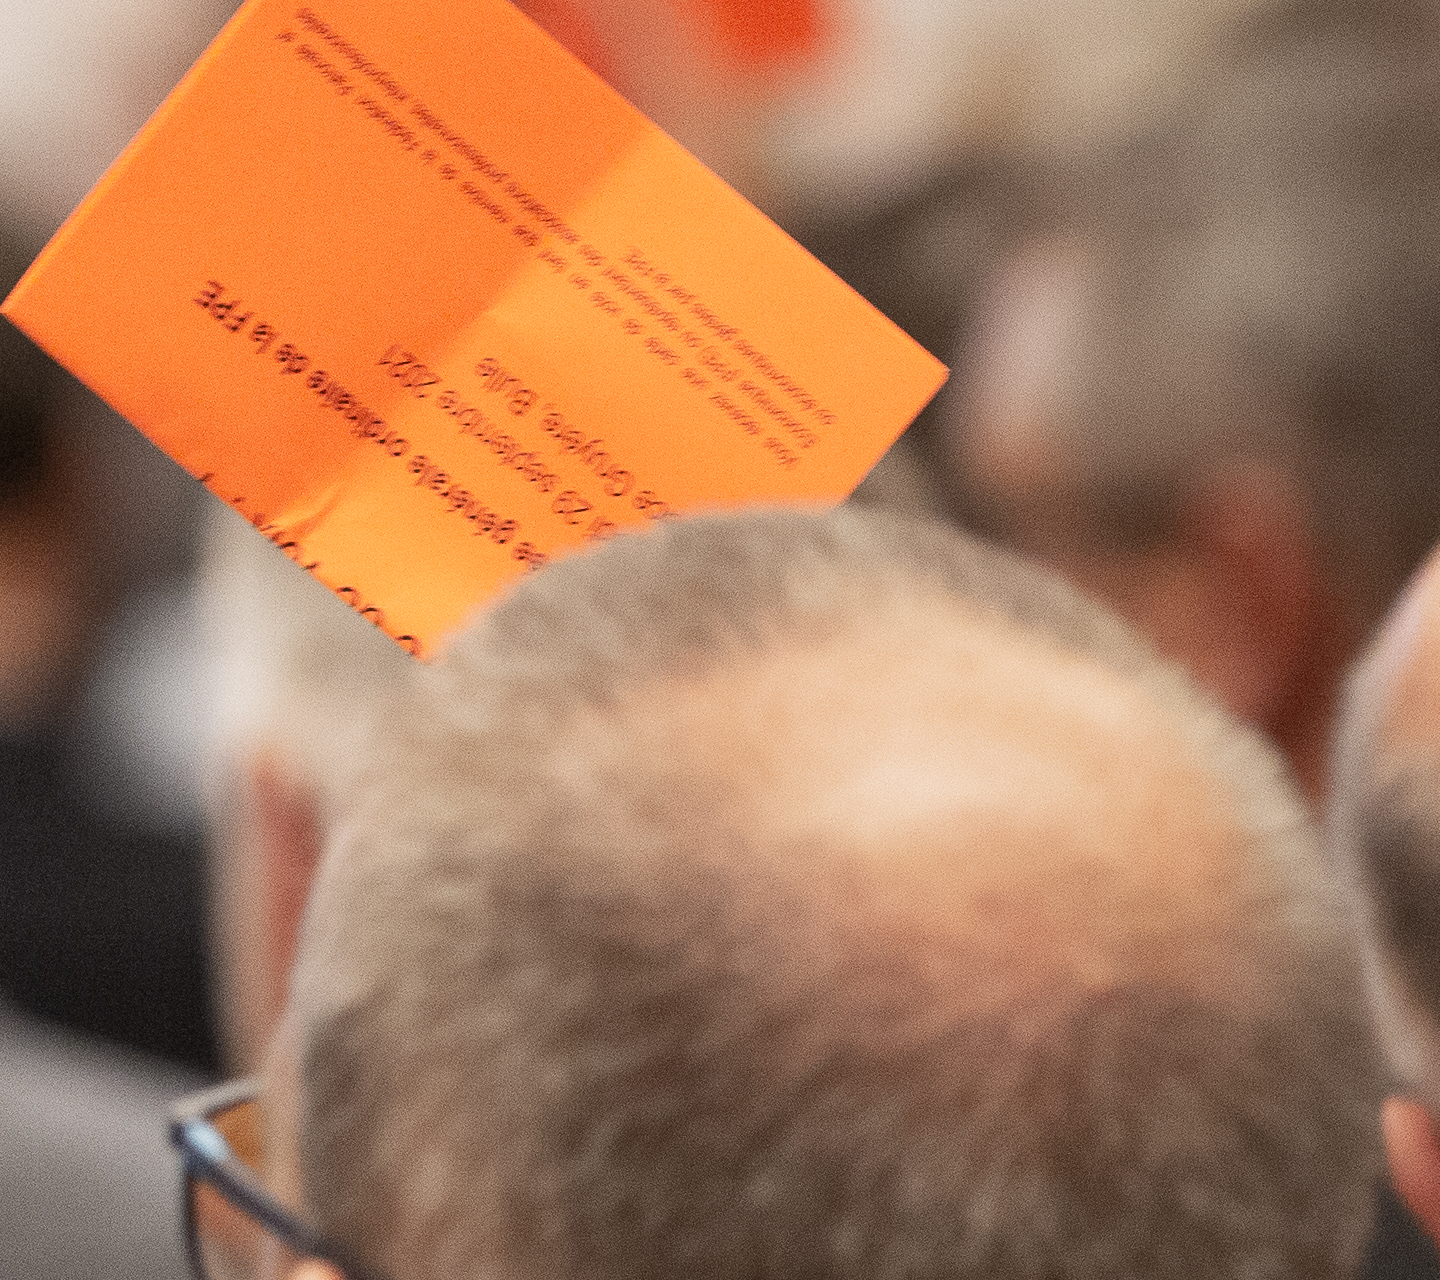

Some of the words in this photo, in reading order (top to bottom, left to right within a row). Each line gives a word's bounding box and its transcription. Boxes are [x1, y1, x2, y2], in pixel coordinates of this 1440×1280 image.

[190, 278, 255, 335] FPE
[246, 320, 280, 355] la
[272, 341, 311, 376] de
[375, 343, 442, 400] 2021
[474, 355, 540, 418] Bulle
[304, 368, 410, 458] ordinaire
[437, 388, 559, 494] septembre
[406, 453, 521, 546] générale
[550, 488, 595, 527] 29
